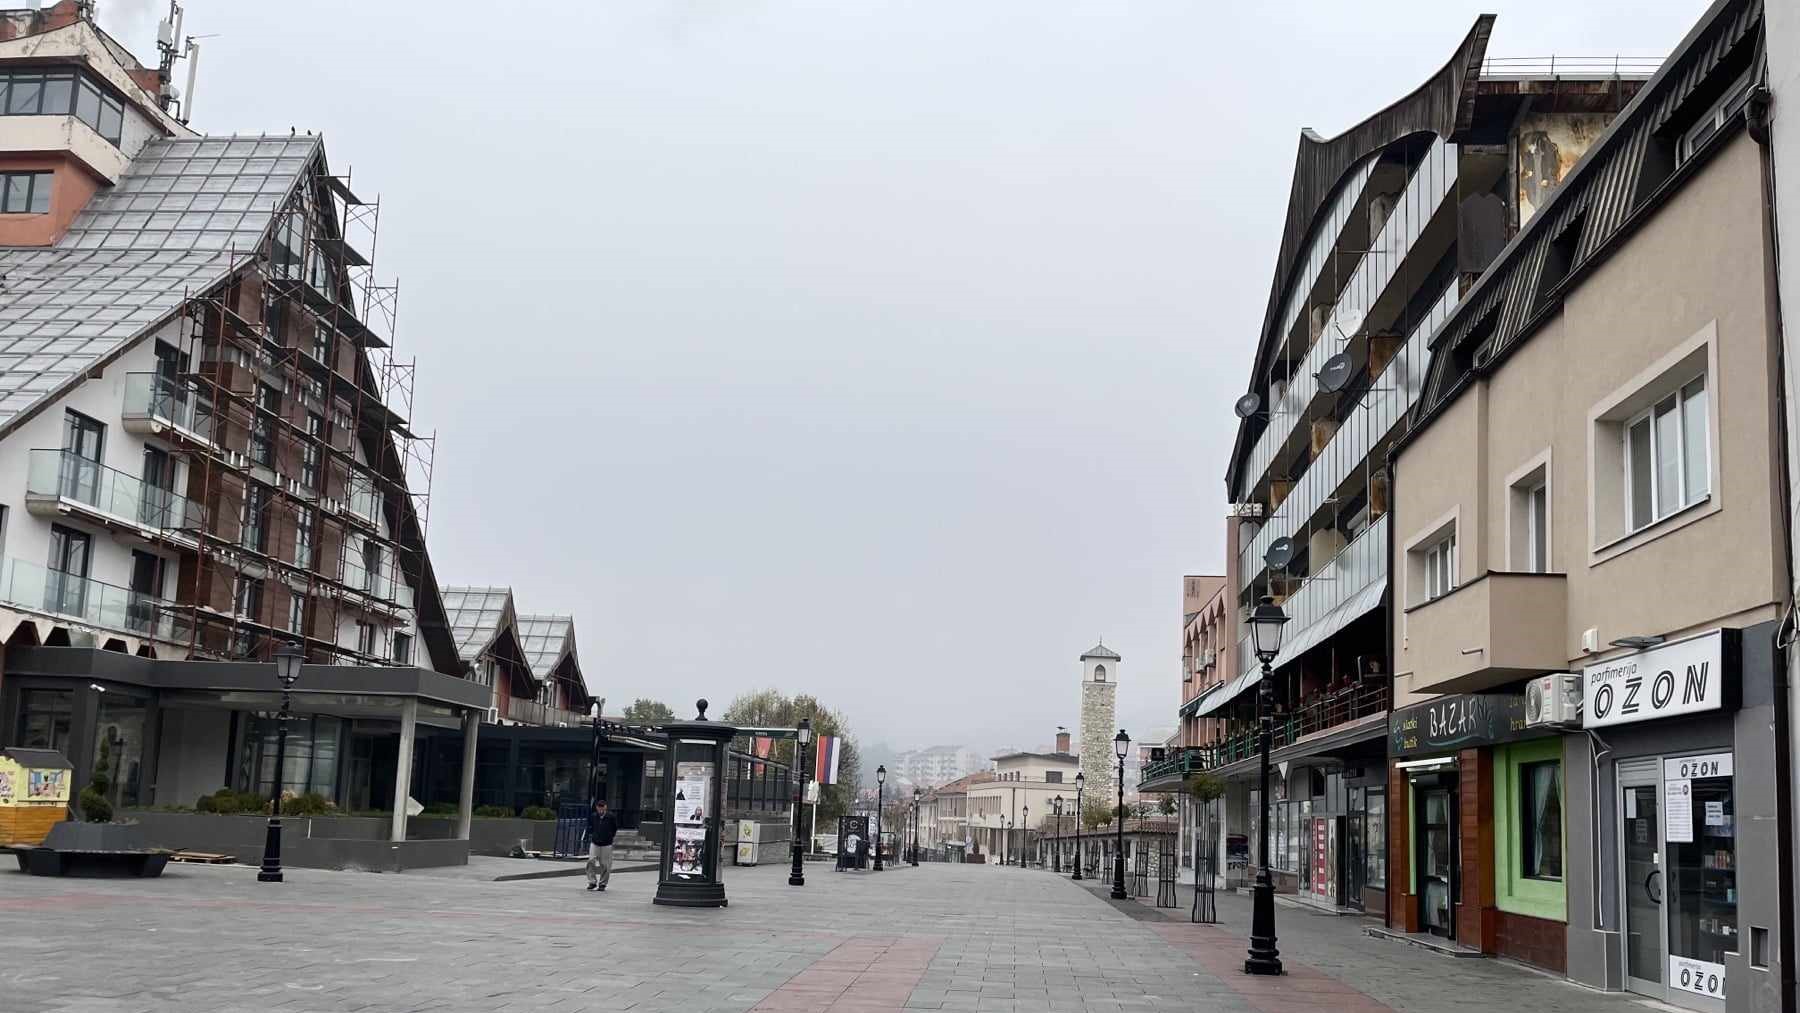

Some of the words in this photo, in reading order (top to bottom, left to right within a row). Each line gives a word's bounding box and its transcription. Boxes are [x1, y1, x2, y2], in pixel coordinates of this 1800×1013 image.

[1591, 662, 1637, 685] parfimerija
[1594, 661, 1709, 719] OZON
[1680, 761, 1719, 778] OZON
